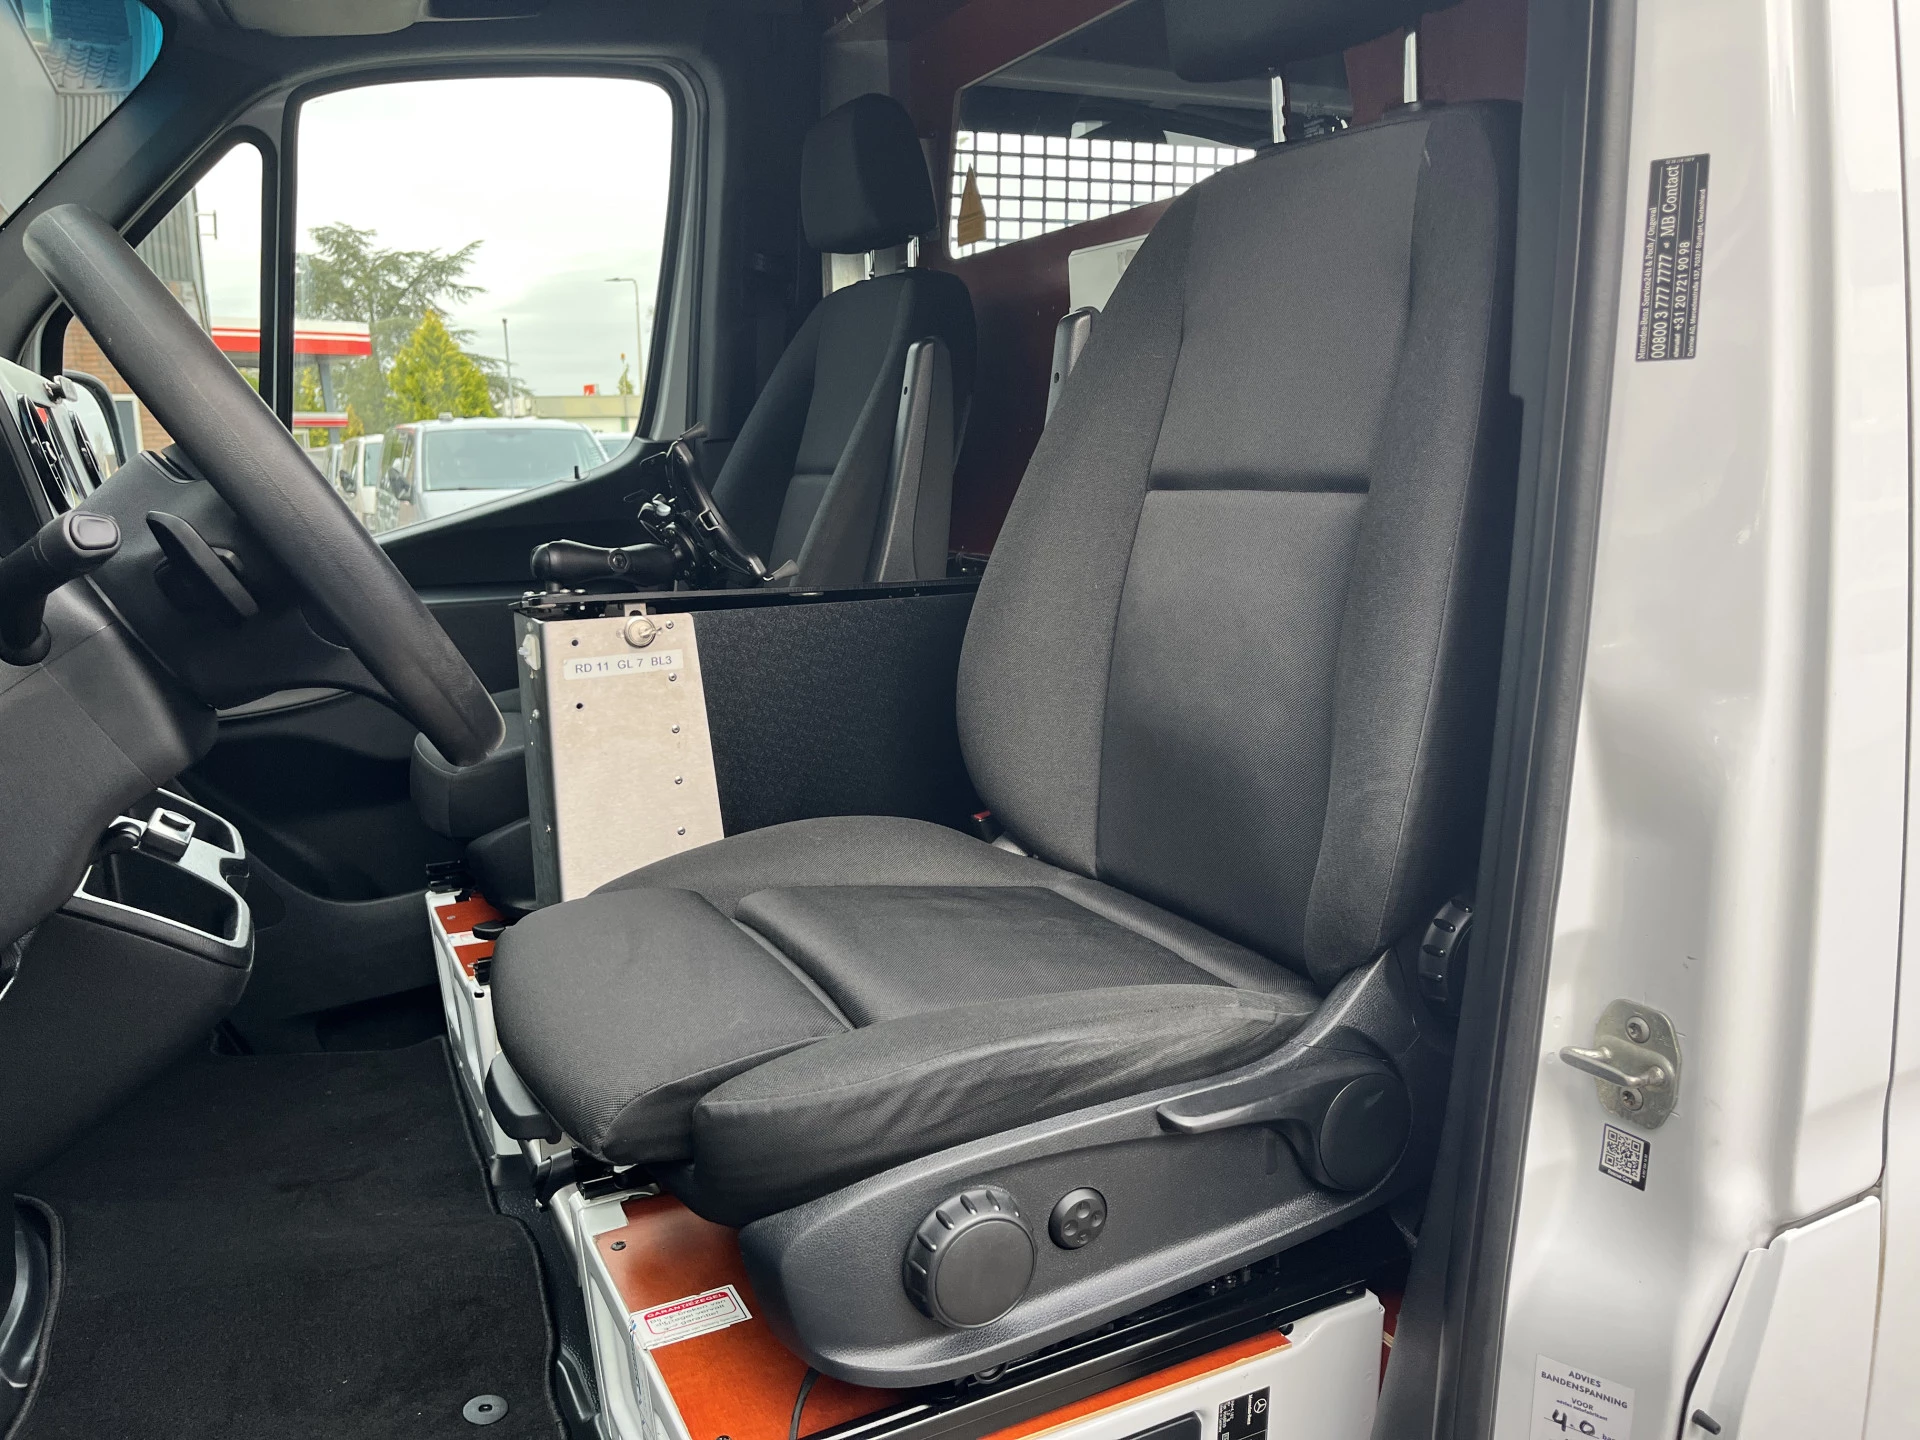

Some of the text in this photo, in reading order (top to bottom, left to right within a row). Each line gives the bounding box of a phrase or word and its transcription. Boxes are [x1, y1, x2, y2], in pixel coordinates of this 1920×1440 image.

[1662, 164, 1680, 213] Contact
[1647, 207, 1658, 236] Ongeval
[1660, 216, 1676, 237] MB
[1645, 243, 1655, 260] Pech
[1679, 241, 1690, 255] 98
[1657, 254, 1672, 284] 7777
[1677, 257, 1689, 271] 90
[1676, 273, 1688, 293] 721
[1654, 286, 1670, 309] 777
[1674, 295, 1686, 308] 20
[1654, 311, 1668, 319] 3
[1673, 311, 1685, 331] +31
[1650, 321, 1667, 358] 00800
[575, 655, 672, 674] RD 11 GL 7 BL3
[646, 1293, 725, 1319] GARANTIEZEGEL
[1568, 1370, 1601, 1388] ADVIES
[1541, 1370, 1628, 1409] BANDENSPANNING
[1571, 1397, 1594, 1411] VOOR
